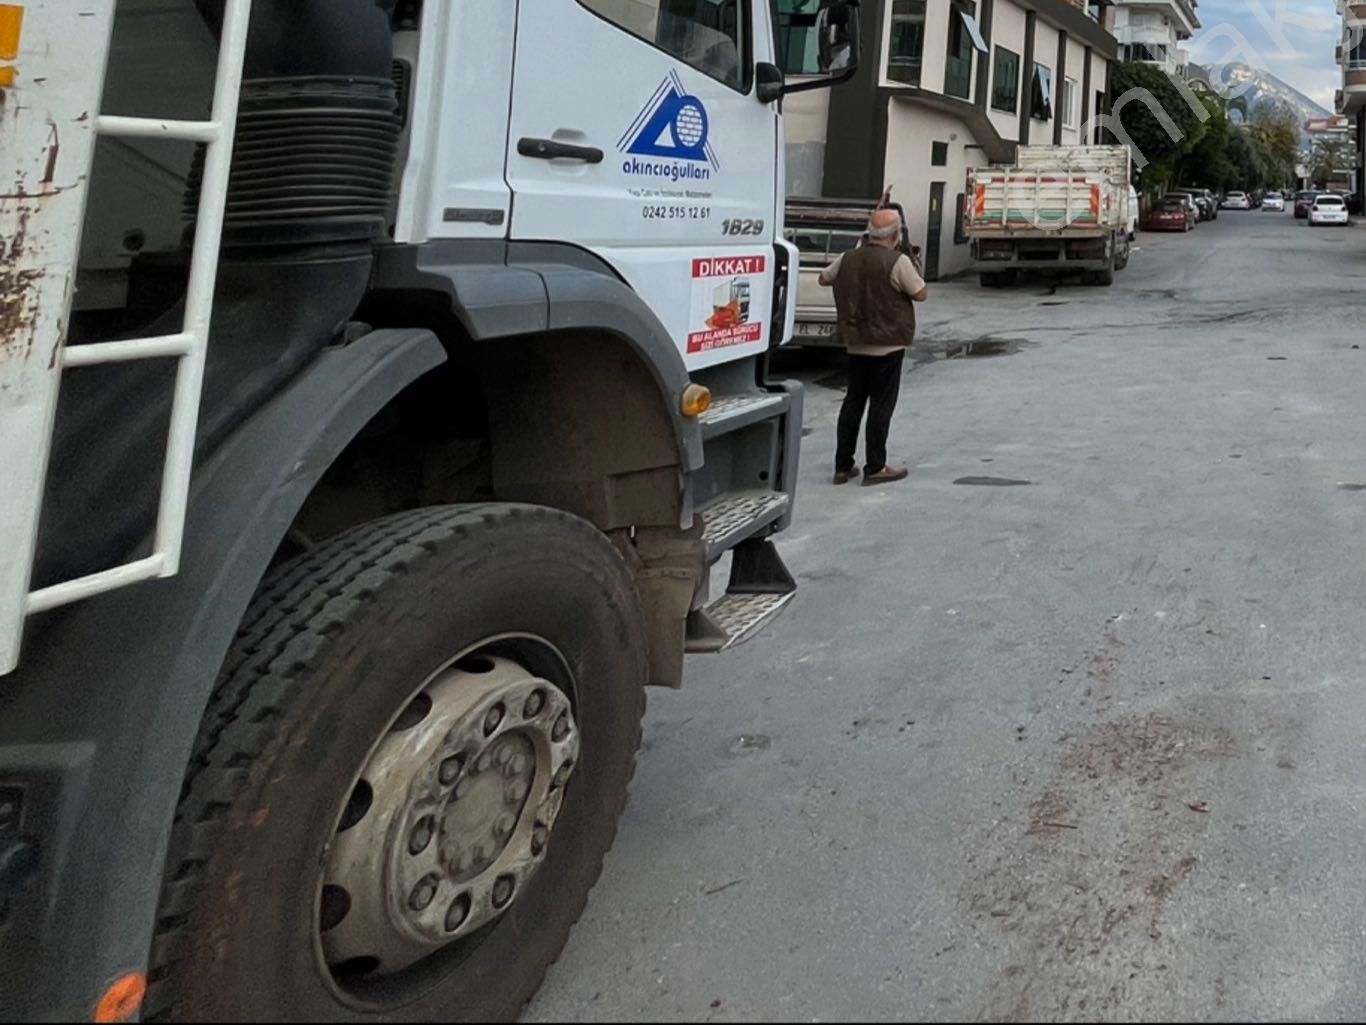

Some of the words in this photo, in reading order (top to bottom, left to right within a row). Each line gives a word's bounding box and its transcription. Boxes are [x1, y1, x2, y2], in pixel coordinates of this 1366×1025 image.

[622, 157, 710, 182] akıncıoğulları
[642, 206, 666, 219] 0242
[669, 206, 686, 219] 515
[721, 218, 764, 236] 1829
[700, 258, 752, 276] DİKKAT
